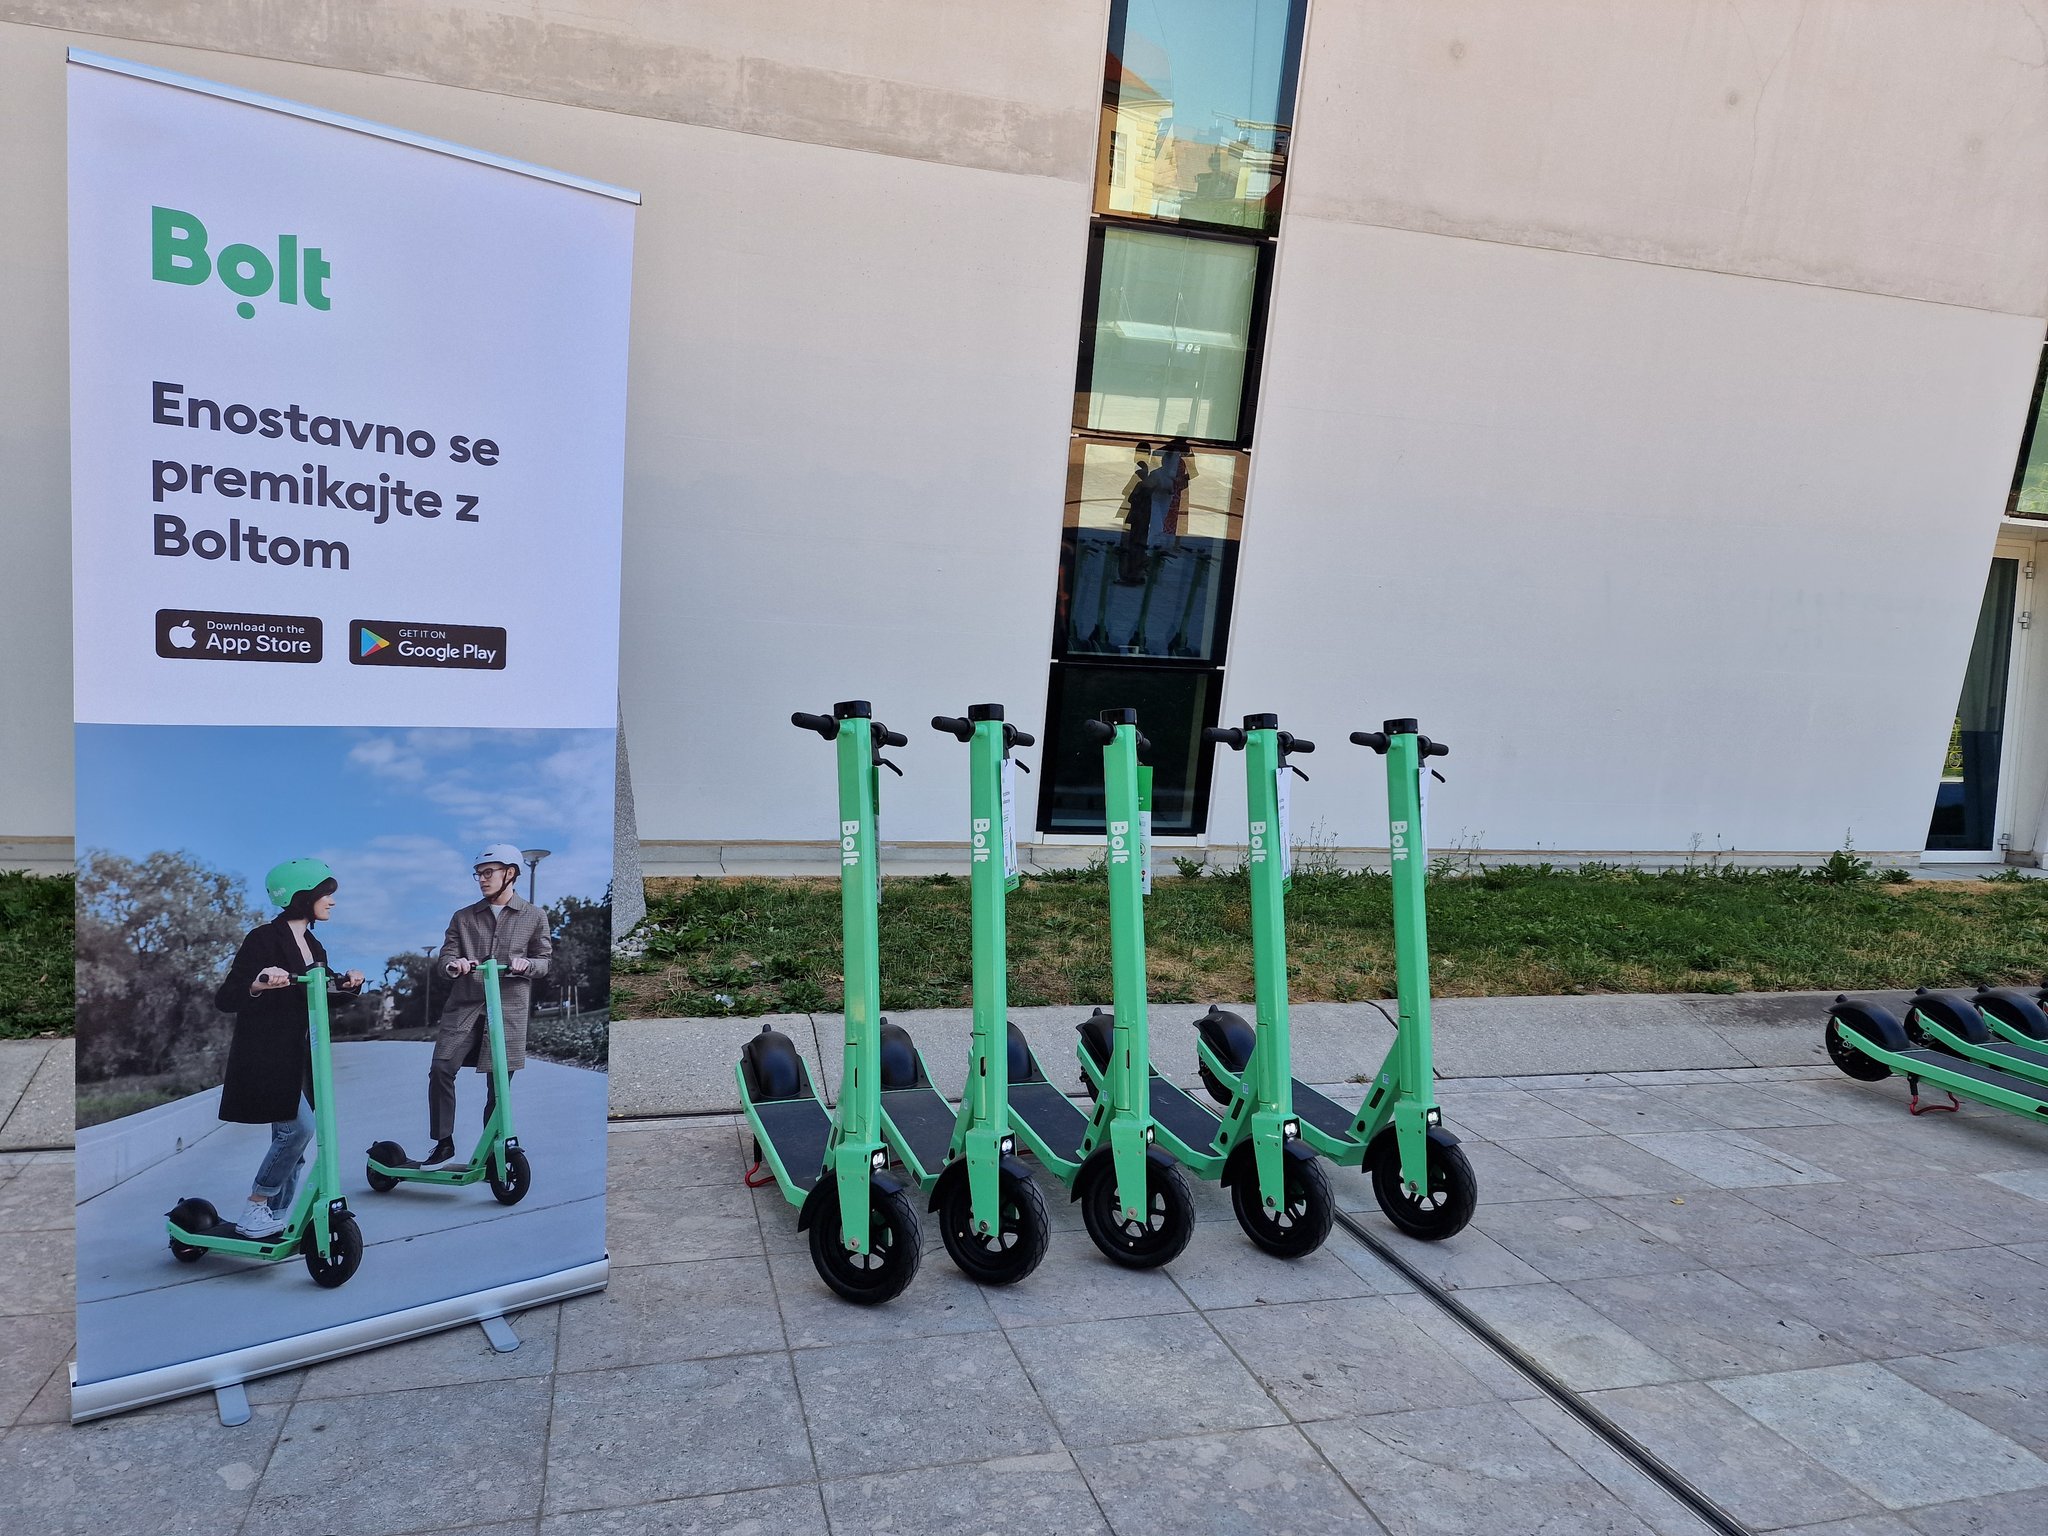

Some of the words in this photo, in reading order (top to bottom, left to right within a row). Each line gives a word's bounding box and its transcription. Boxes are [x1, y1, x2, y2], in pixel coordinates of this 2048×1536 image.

[152, 206, 331, 320] Bolt
[152, 380, 436, 459] Enostavno
[449, 435, 500, 467] se
[152, 459, 443, 525] premikajte
[455, 494, 480, 523] z
[153, 513, 350, 571] Boltom
[205, 632, 251, 655] App
[256, 634, 312, 654] Store
[206, 620, 266, 633] Download
[269, 626, 284, 634] on
[287, 625, 305, 634] the
[399, 629, 418, 638] GET
[420, 630, 429, 639] IT
[430, 631, 446, 639] ON
[398, 640, 460, 662] Google
[463, 643, 497, 664] Play
[841, 820, 860, 867] Bolt
[972, 818, 991, 863] Bolt
[1109, 821, 1130, 864] Bolt
[1250, 821, 1268, 863] Bolt
[1391, 820, 1409, 861] Bolt
